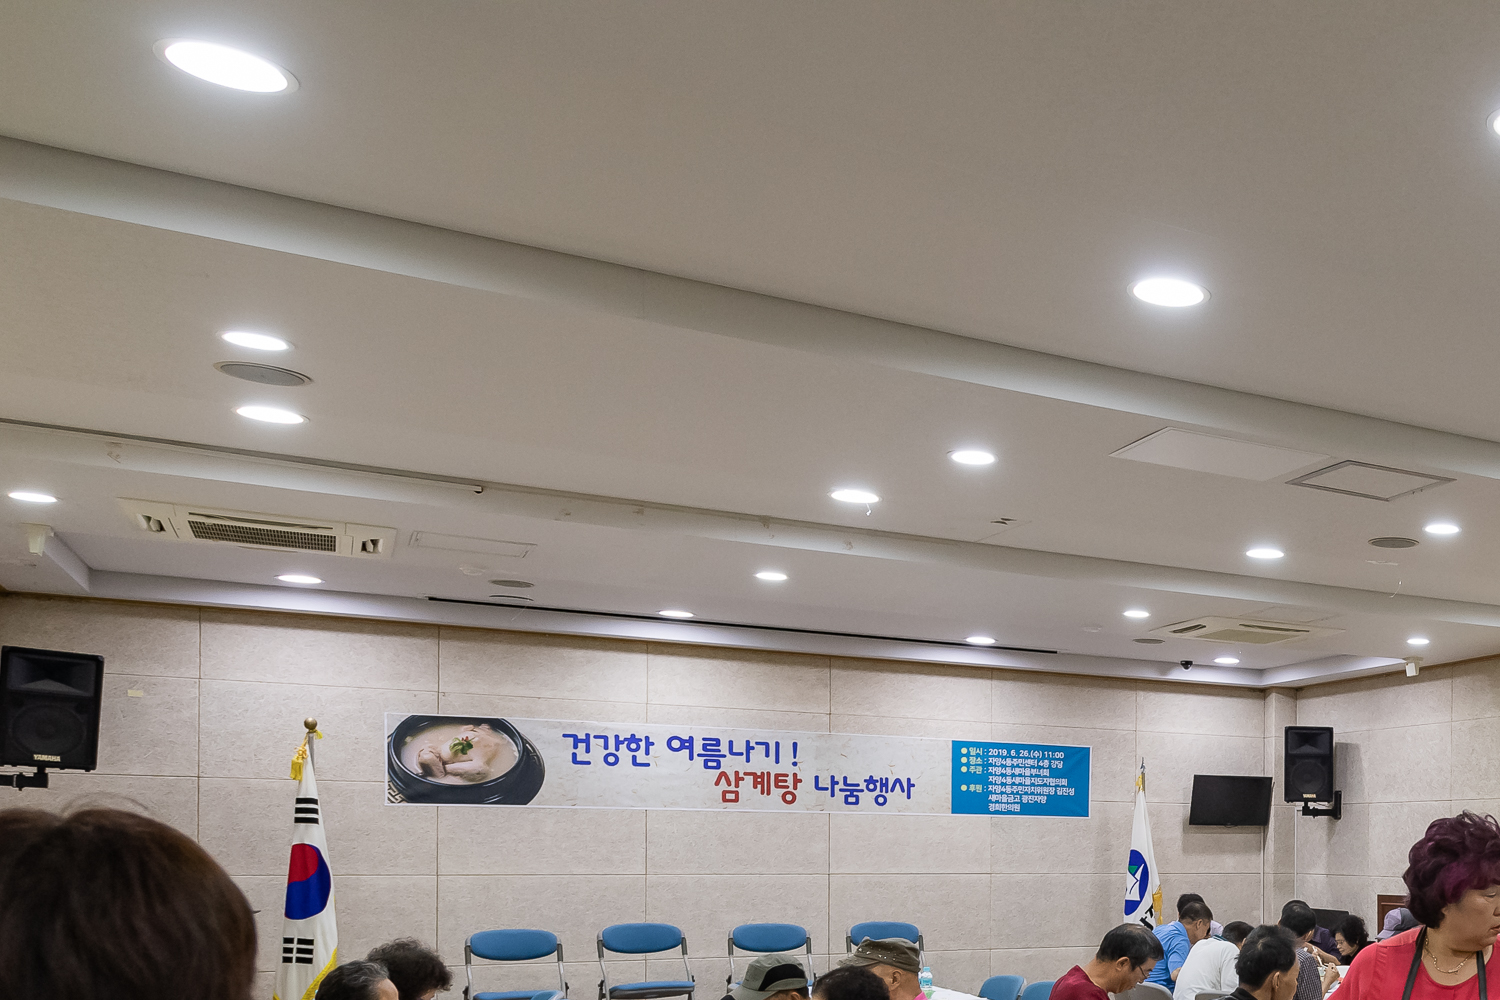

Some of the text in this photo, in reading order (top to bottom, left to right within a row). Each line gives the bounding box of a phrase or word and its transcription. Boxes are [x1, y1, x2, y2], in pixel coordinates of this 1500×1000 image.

[562, 733, 655, 767] 건강한
[969, 747, 983, 755] 일시
[988, 748, 1009, 756] 2019.
[1044, 751, 1064, 759] 11:00
[969, 756, 983, 764] 장소
[1050, 760, 1063, 769] 강당
[714, 771, 915, 807] 삼계탕 나눔행사
